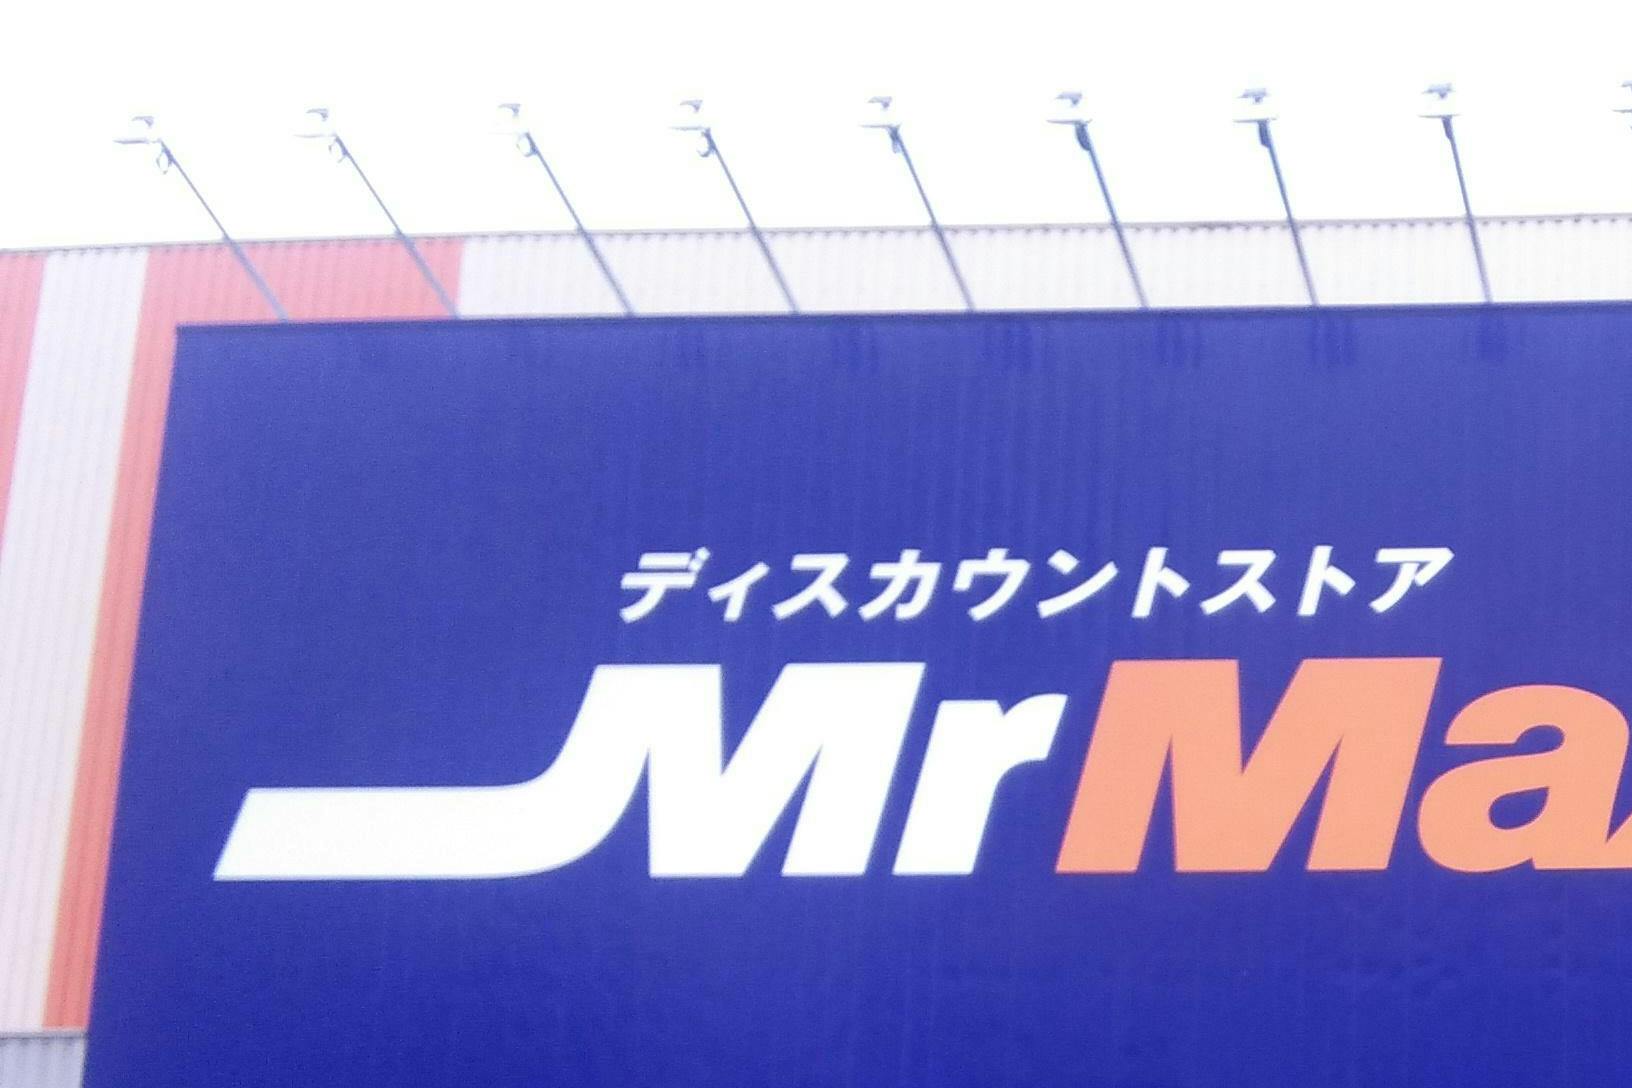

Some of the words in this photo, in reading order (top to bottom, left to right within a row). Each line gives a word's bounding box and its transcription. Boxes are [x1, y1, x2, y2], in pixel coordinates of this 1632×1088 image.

[621, 546, 1453, 622] ディスカウントストア
